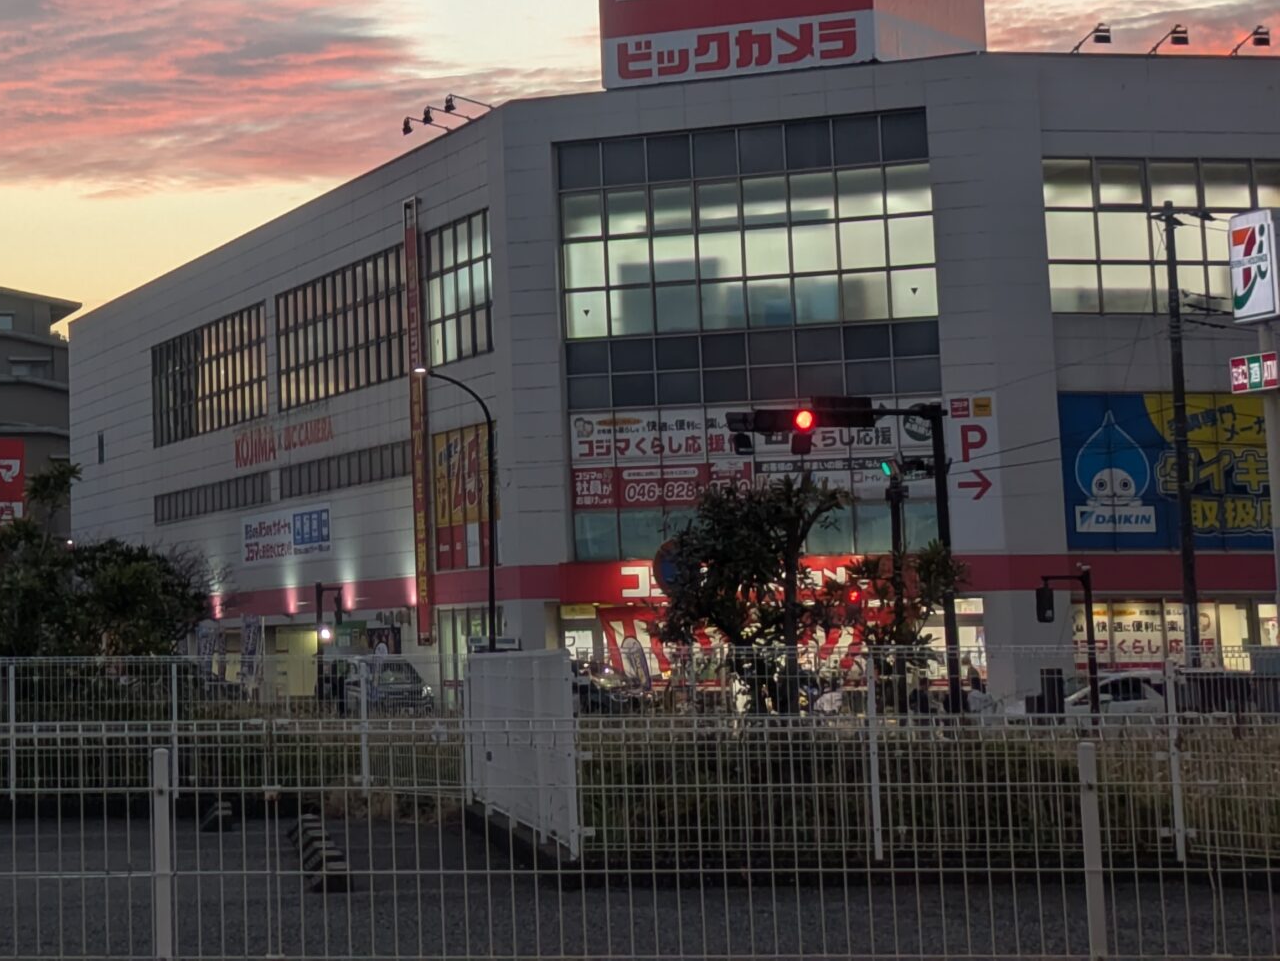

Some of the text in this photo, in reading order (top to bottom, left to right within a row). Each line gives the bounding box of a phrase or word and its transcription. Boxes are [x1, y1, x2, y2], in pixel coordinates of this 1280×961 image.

[616, 18, 857, 80] ビックカメラ
[234, 426, 276, 469] KOJIMA
[960, 424, 987, 463] P
[575, 480, 612, 495] 社員が
[1094, 514, 1152, 525] DAIKIN
